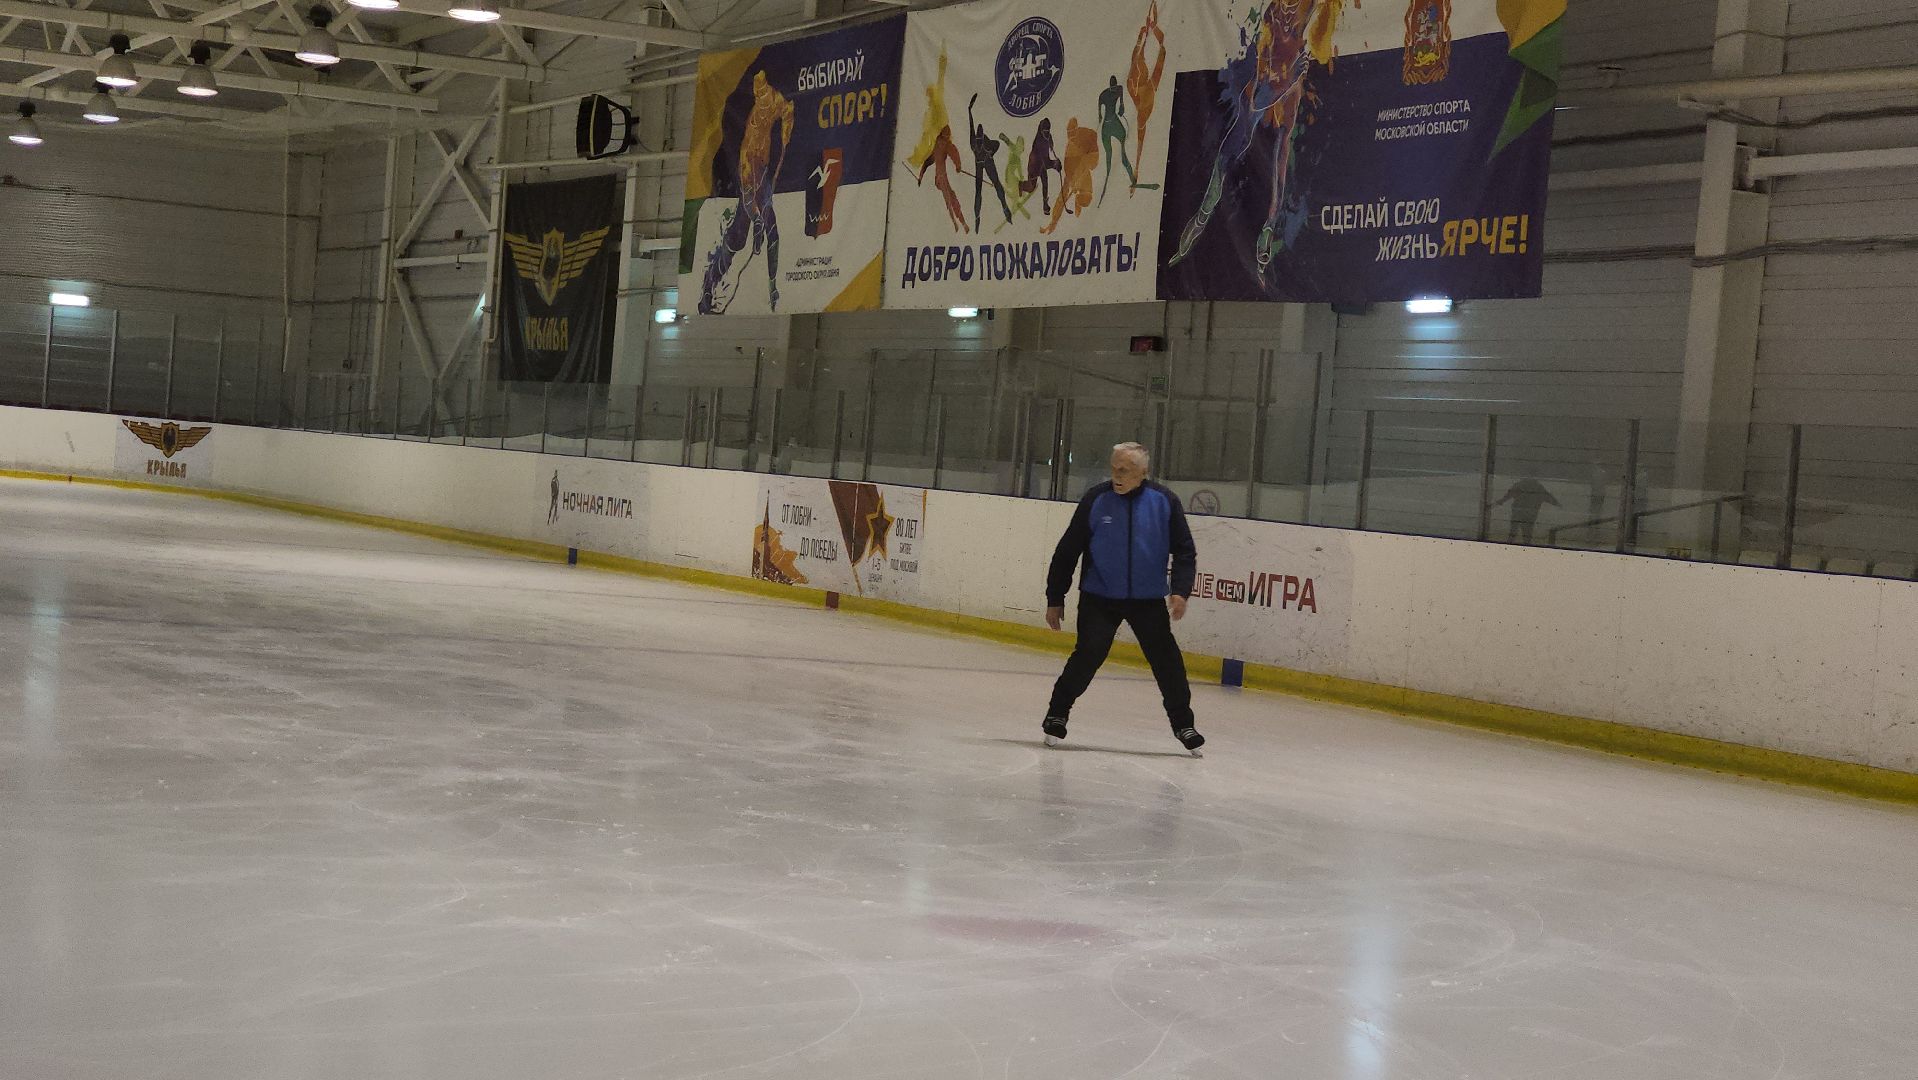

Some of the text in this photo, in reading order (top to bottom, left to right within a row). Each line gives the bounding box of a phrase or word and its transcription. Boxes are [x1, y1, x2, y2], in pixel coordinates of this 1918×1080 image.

[798, 48, 865, 91] ВЫБИРАЙ
[818, 83, 888, 129] СПОРТ!
[1009, 91, 1043, 110] ЛОБНЯ
[1377, 99, 1471, 122] МИНИСТЕРСТВО СПОРТА
[1374, 119, 1470, 141] МОСКОВСКОЙ ОБЛАСТИ
[1321, 196, 1441, 235] СДЕЛАЙ СВОЮ
[1375, 213, 1529, 262] ЖИЗНЬ ЯРЧЕ!
[901, 232, 1141, 289] ДОБРО ПОЖАЛОВАТЬ!
[147, 459, 187, 478] КРЫЛЬЯ
[562, 491, 633, 520] НОЧНАЯ ЛИГА
[781, 503, 790, 524] ОТ
[790, 504, 812, 527] ЛОБНИ
[895, 517, 918, 539] 80 ЛЕТ
[799, 536, 839, 564] ДО ПОБЕДЫ
[1218, 581, 1243, 600] ЧЕМ
[1248, 571, 1317, 614] ИГРА
